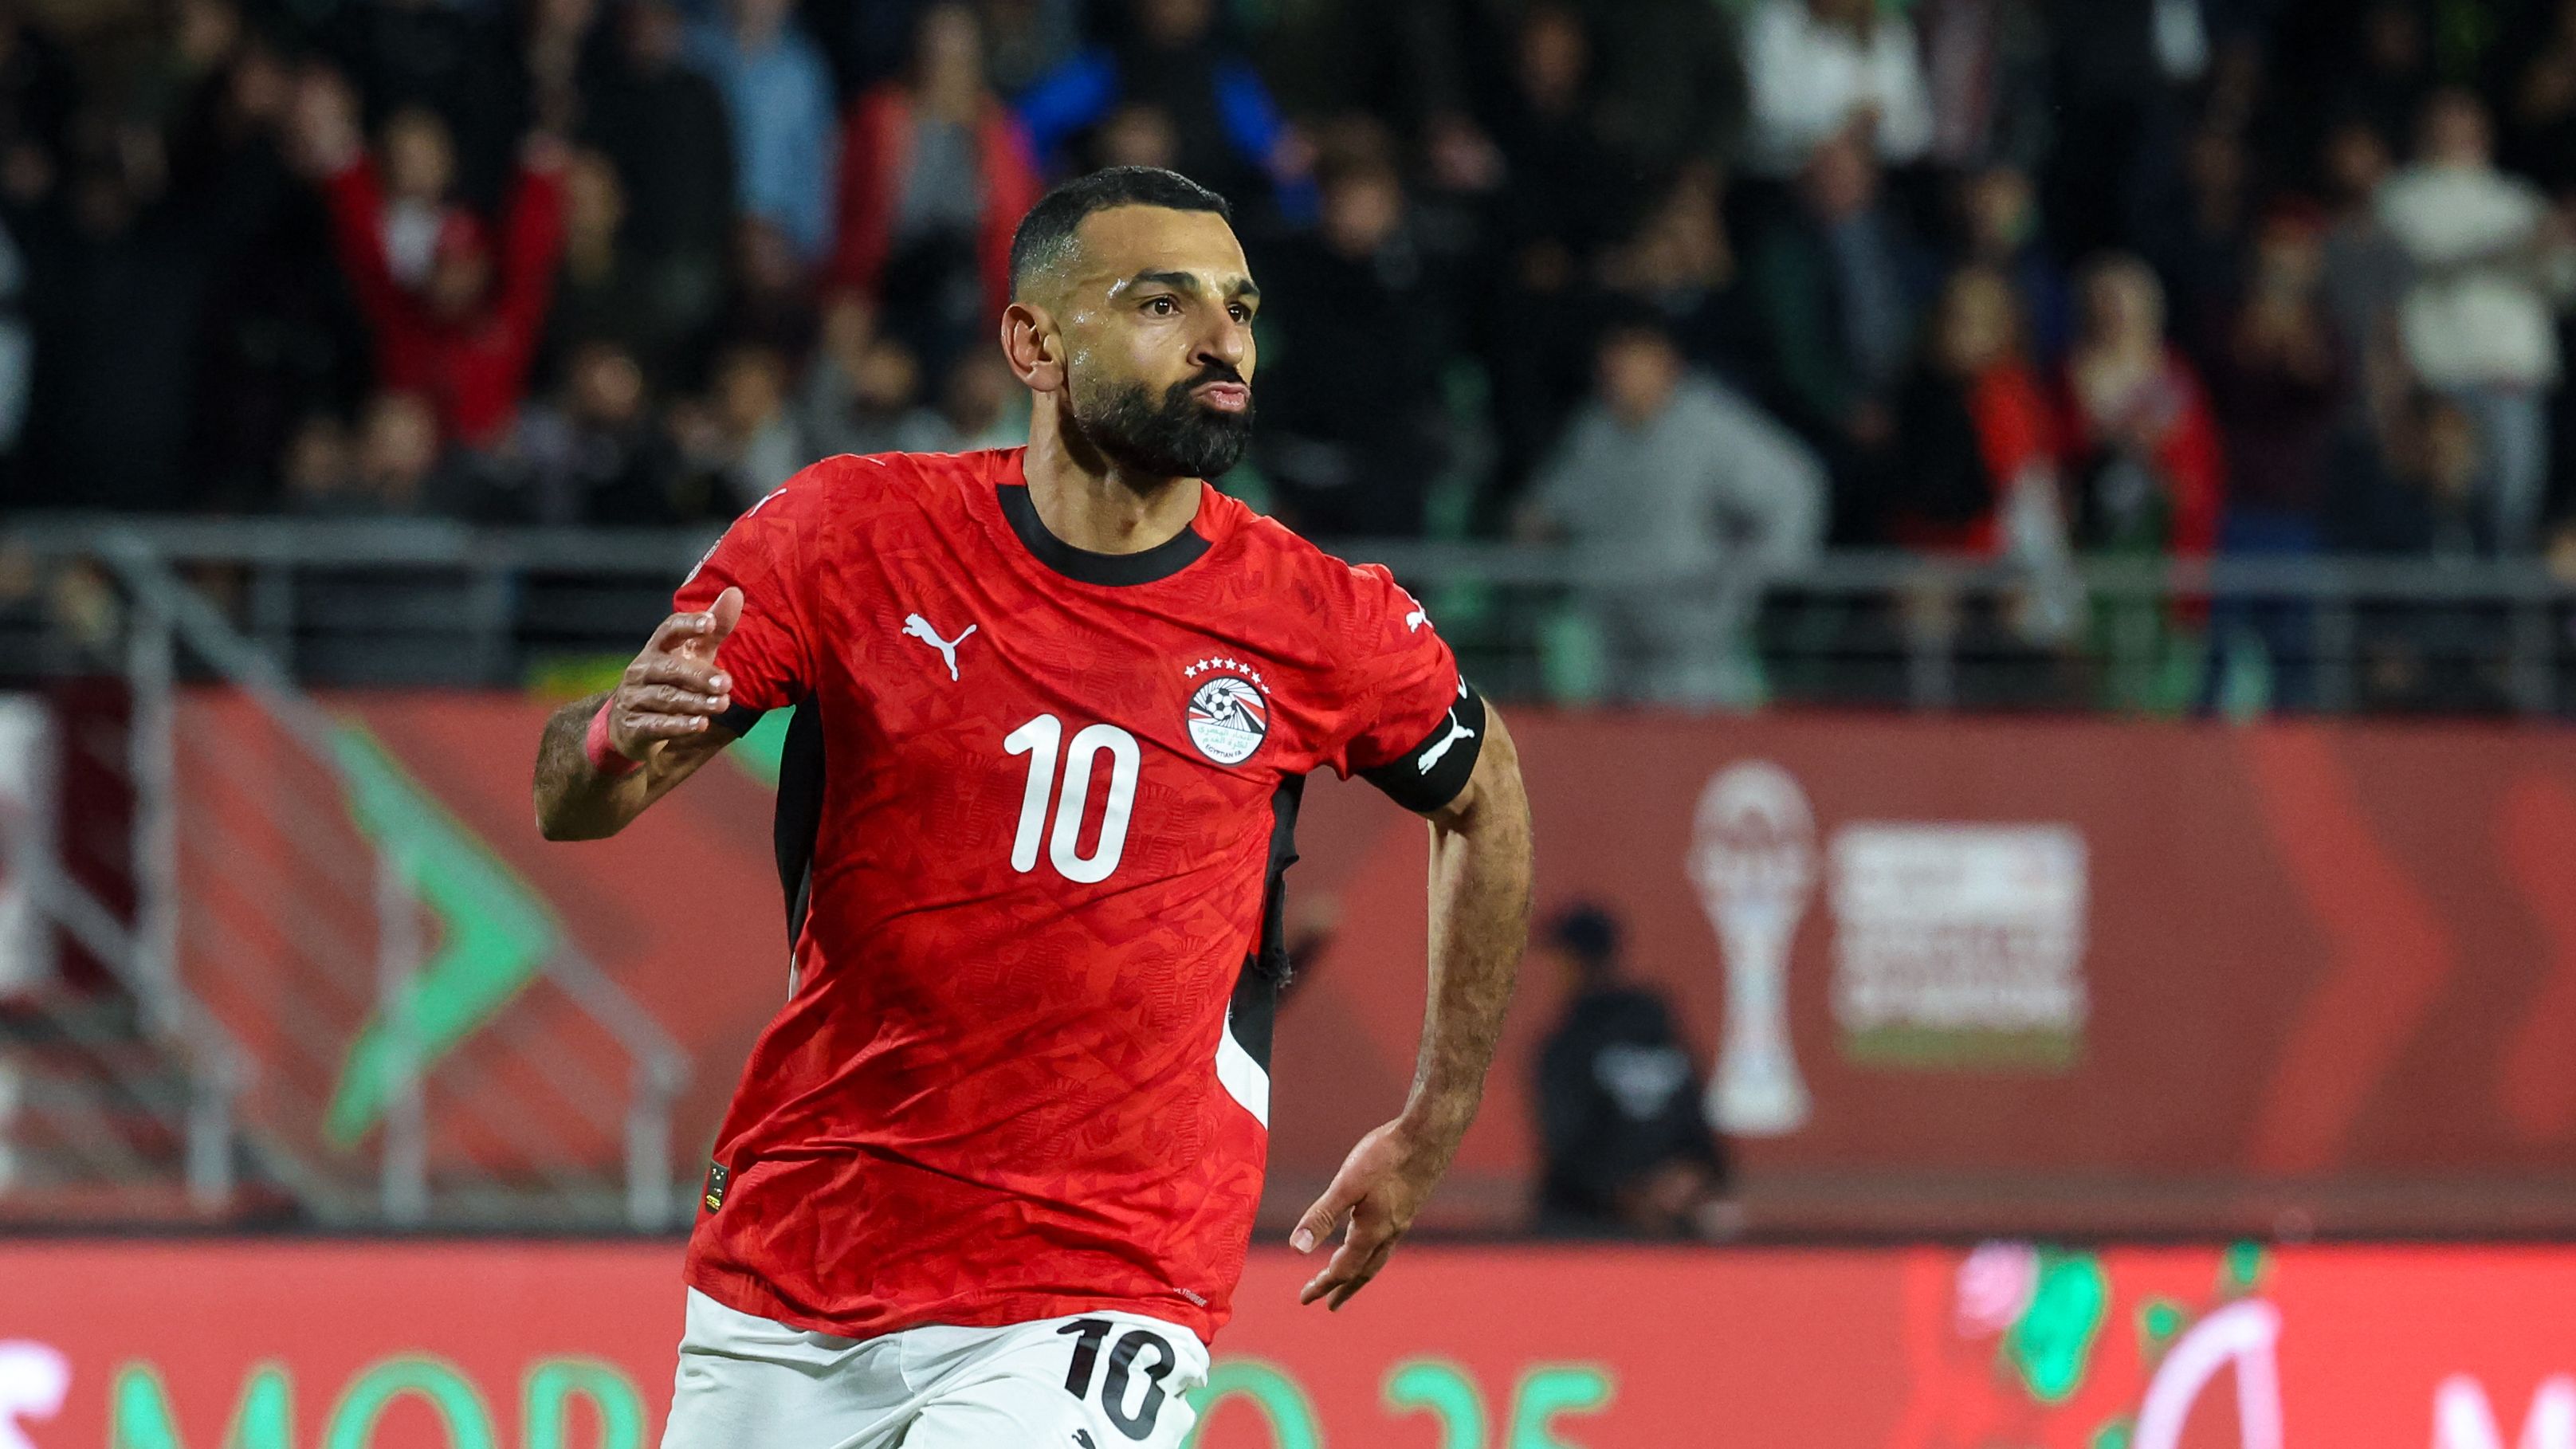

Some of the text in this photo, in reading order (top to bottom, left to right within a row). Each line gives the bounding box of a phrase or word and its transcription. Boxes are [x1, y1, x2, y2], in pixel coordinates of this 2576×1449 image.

[1003, 713, 1141, 883] 10
[1205, 744, 1233, 758] EGYPTIAN
[1056, 1319, 1176, 1440] 10
